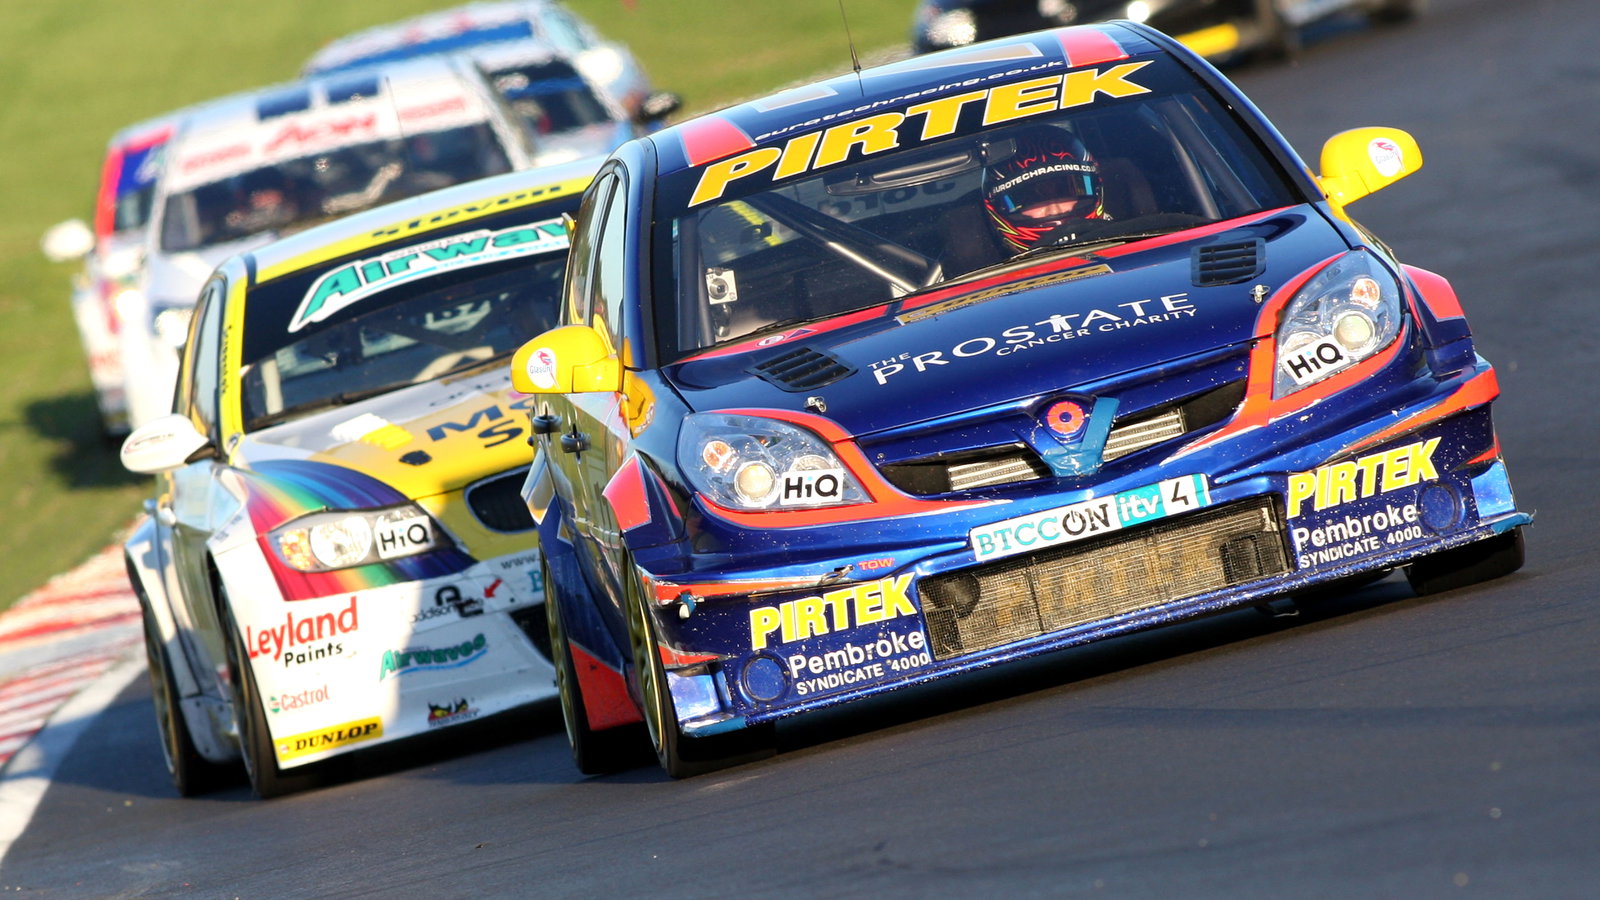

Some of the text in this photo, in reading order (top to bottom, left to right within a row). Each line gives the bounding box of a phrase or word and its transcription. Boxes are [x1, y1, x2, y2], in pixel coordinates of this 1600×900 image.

[754, 60, 1064, 141] eurotechracing.co.uk
[688, 61, 1153, 207] PIRTEK
[873, 293, 1196, 386] PROSTATE
[996, 308, 1197, 356] CANCER CHARITY
[868, 352, 911, 370] THE
[1287, 343, 1344, 379] HiQ
[784, 474, 839, 500] HiQ
[1286, 436, 1442, 520] PIRTEK
[380, 523, 429, 551] HiQ
[975, 481, 1190, 556] BTCC ON itv 4
[1292, 504, 1418, 552] Pembroke
[858, 558, 895, 571] TOW
[1300, 526, 1422, 569] SYNDICATE 4000
[246, 596, 358, 662] Leyland
[749, 572, 918, 651] PIRTEK
[284, 643, 343, 668] Paints
[380, 632, 487, 682] Airwaves
[789, 631, 924, 679] Pembroke
[796, 653, 931, 695] SYNDICATE 4000
[281, 684, 330, 711] Castrol
[294, 722, 378, 751] DUNLOP
